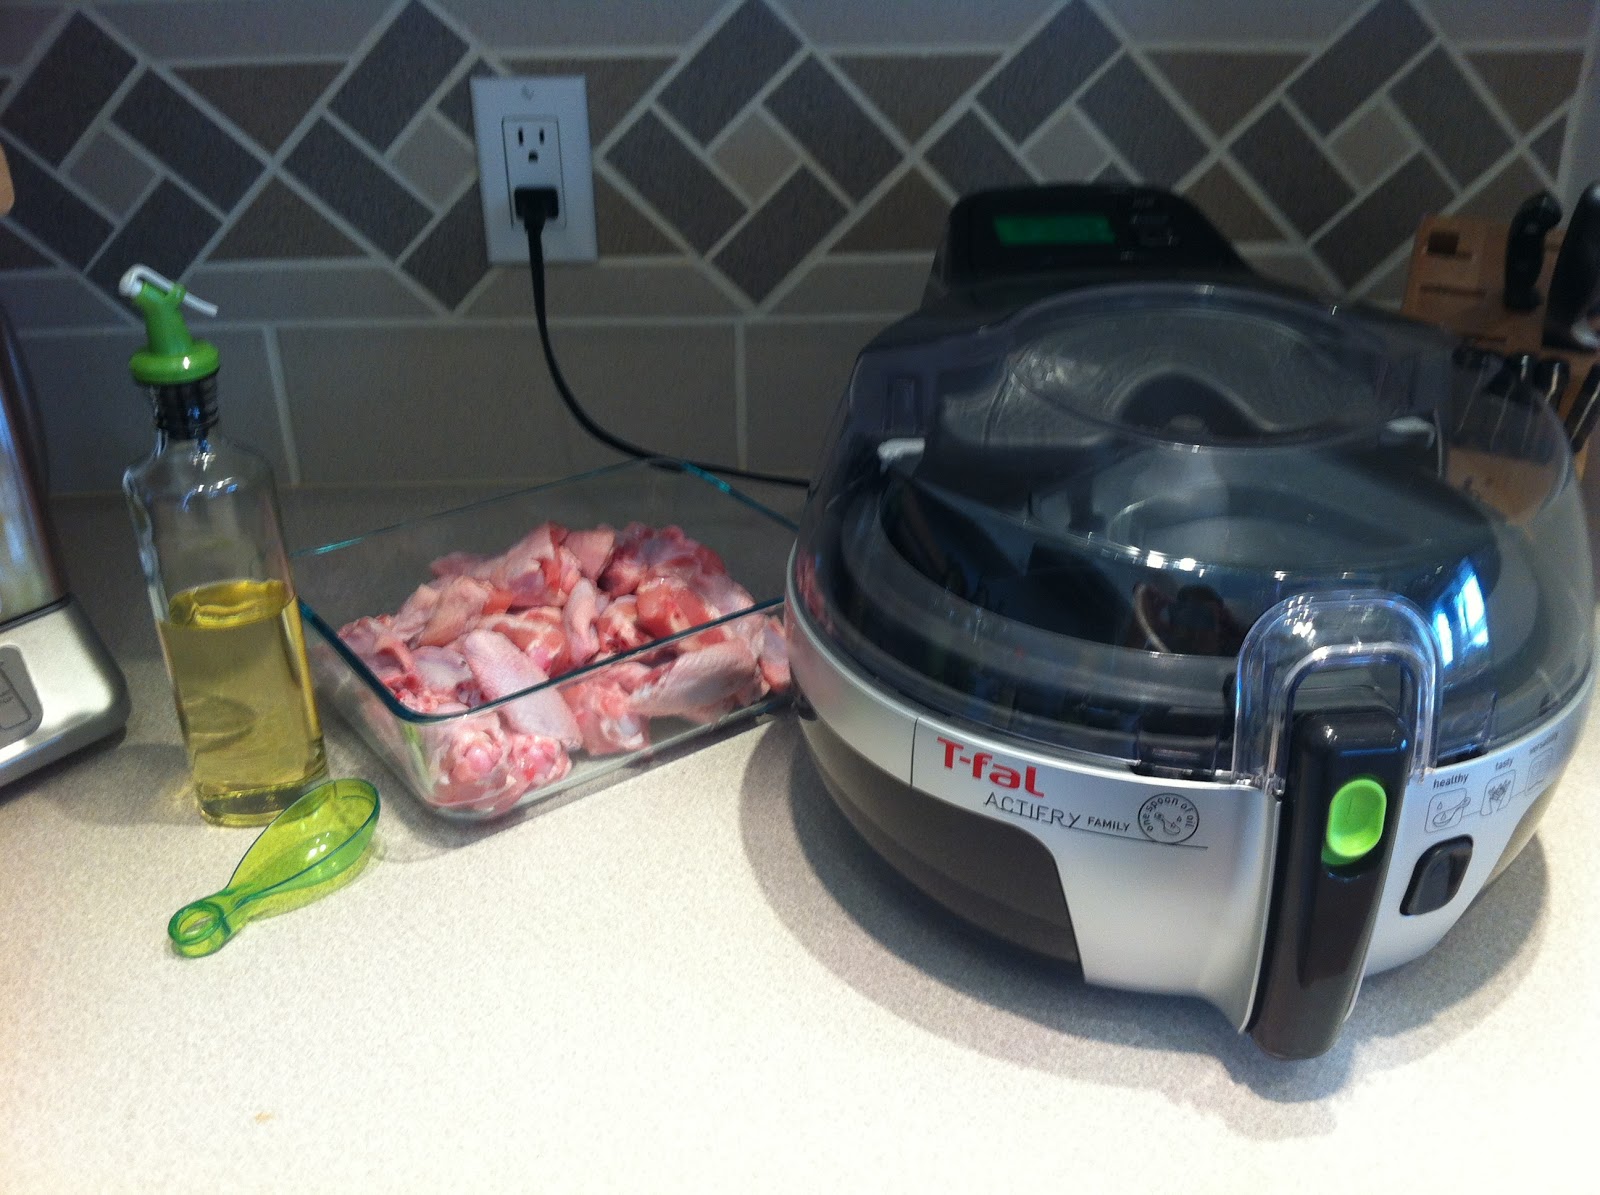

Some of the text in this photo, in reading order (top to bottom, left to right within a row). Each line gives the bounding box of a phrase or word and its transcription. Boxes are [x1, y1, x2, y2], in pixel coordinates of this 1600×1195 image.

[937, 736, 1044, 798] T-fal
[1432, 773, 1469, 789] healthy
[1495, 757, 1514, 771] tasty
[983, 791, 1131, 833] ACTIFRY FAMILY
[1142, 796, 1195, 832] one spoon of oil
